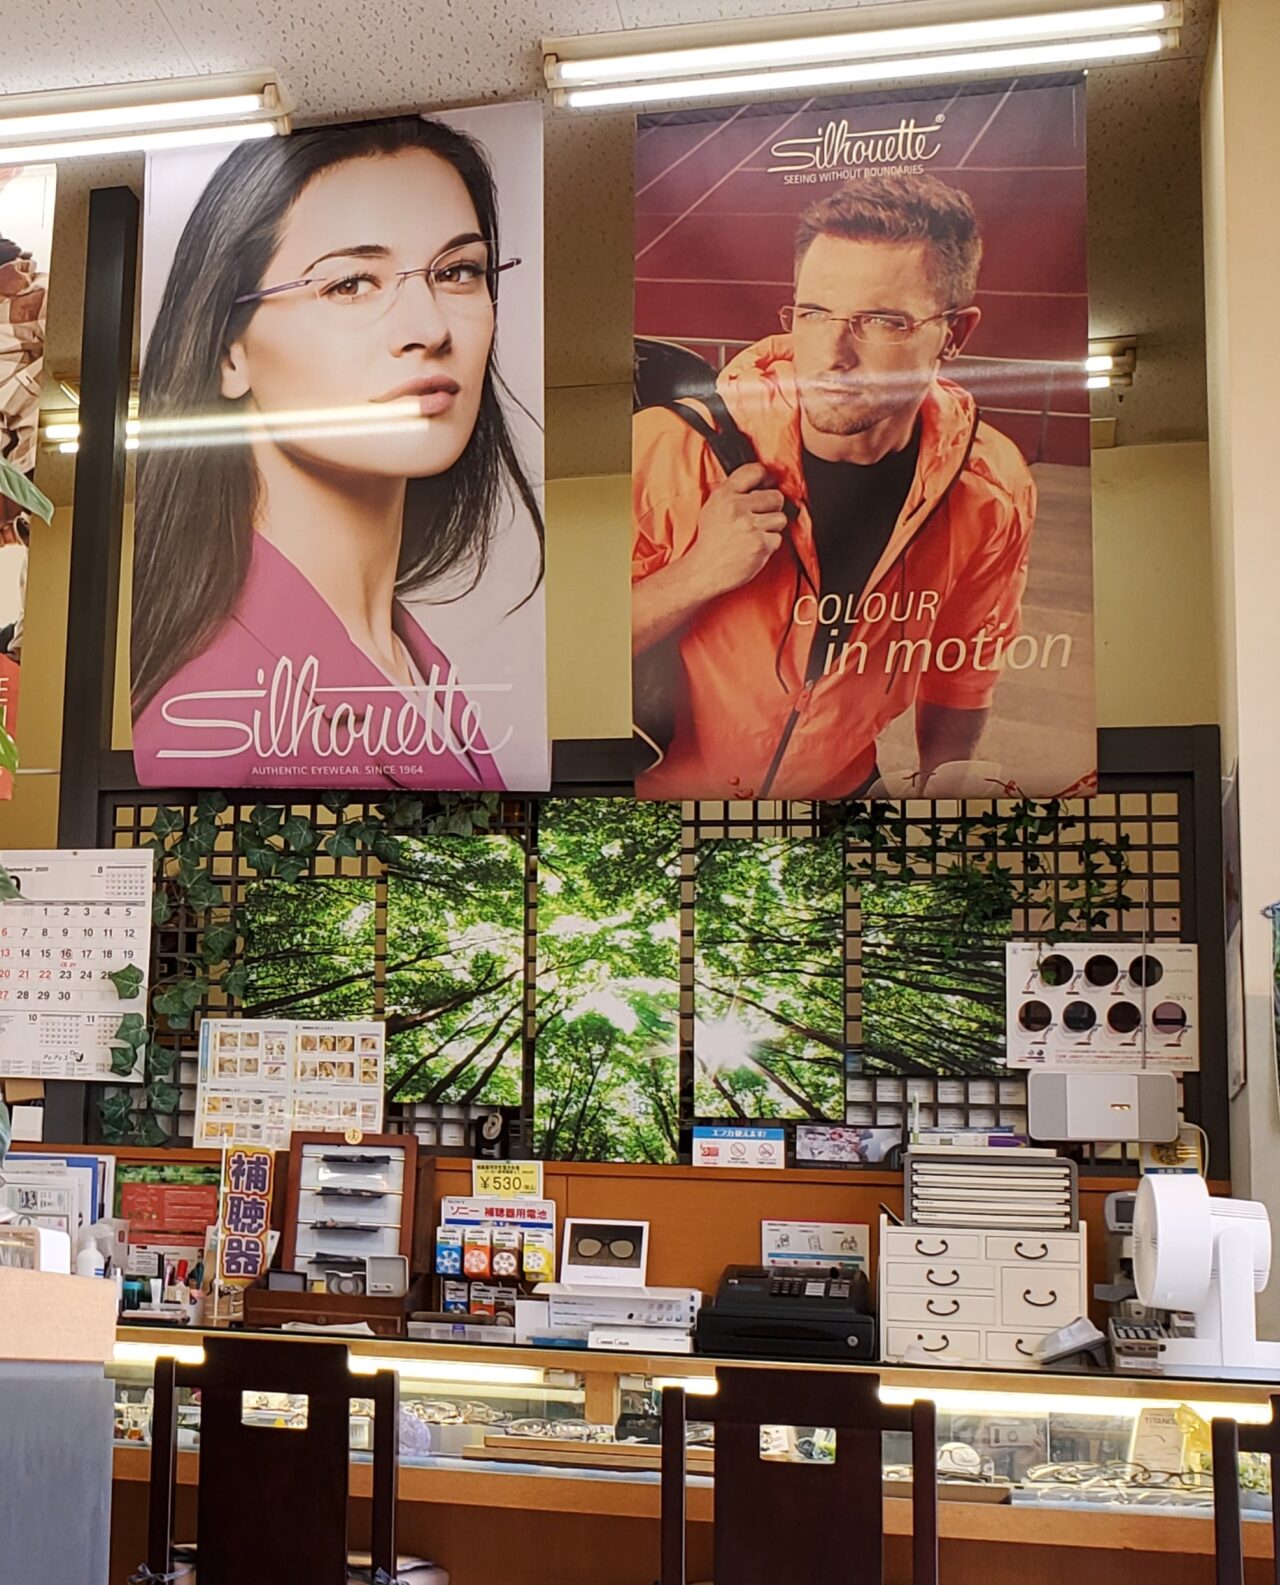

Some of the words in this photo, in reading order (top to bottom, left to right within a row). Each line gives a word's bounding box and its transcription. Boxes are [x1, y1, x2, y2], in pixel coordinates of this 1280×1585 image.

[767, 119, 941, 172] Silhouette
[784, 173, 816, 185] SEEING
[820, 169, 862, 183] WITHOUT
[864, 164, 925, 178] BOUNDARIES
[793, 591, 940, 626] COLOUR
[823, 629, 868, 676] in
[885, 623, 1073, 674] motion
[156, 655, 513, 759] Silhouette
[252, 766, 307, 775] AUTHENTIC
[365, 766, 396, 775] SINCE
[44, 908, 48, 916] 1
[64, 908, 70, 916] 2
[84, 908, 90, 916] 3
[104, 908, 110, 916] 4
[126, 908, 131, 916] 5
[2, 928, 7, 936] 6
[22, 928, 28, 936] 7
[42, 928, 48, 936] 8
[62, 928, 68, 936] 9
[84, 928, 93, 936] 10
[104, 928, 113, 936] 11
[125, 928, 135, 936] 12
[1, 950, 10, 958] 13
[21, 950, 30, 958] 14
[41, 950, 51, 958] 15
[61, 950, 71, 958] 16
[82, 950, 92, 958] 17
[103, 950, 112, 958] 18
[124, 950, 133, 958] 19
[0, 970, 10, 979] 20
[19, 970, 29, 979] 21
[39, 970, 51, 979] 22
[60, 970, 71, 979] 23
[80, 970, 92, 979] 24
[17, 991, 29, 1000] 28
[38, 991, 50, 1000] 29
[58, 991, 70, 1000] 30
[225, 1154, 268, 1275] 補聴器
[450, 1206, 479, 1216] ソニー
[484, 1207, 548, 1220] 補聴器用電池
